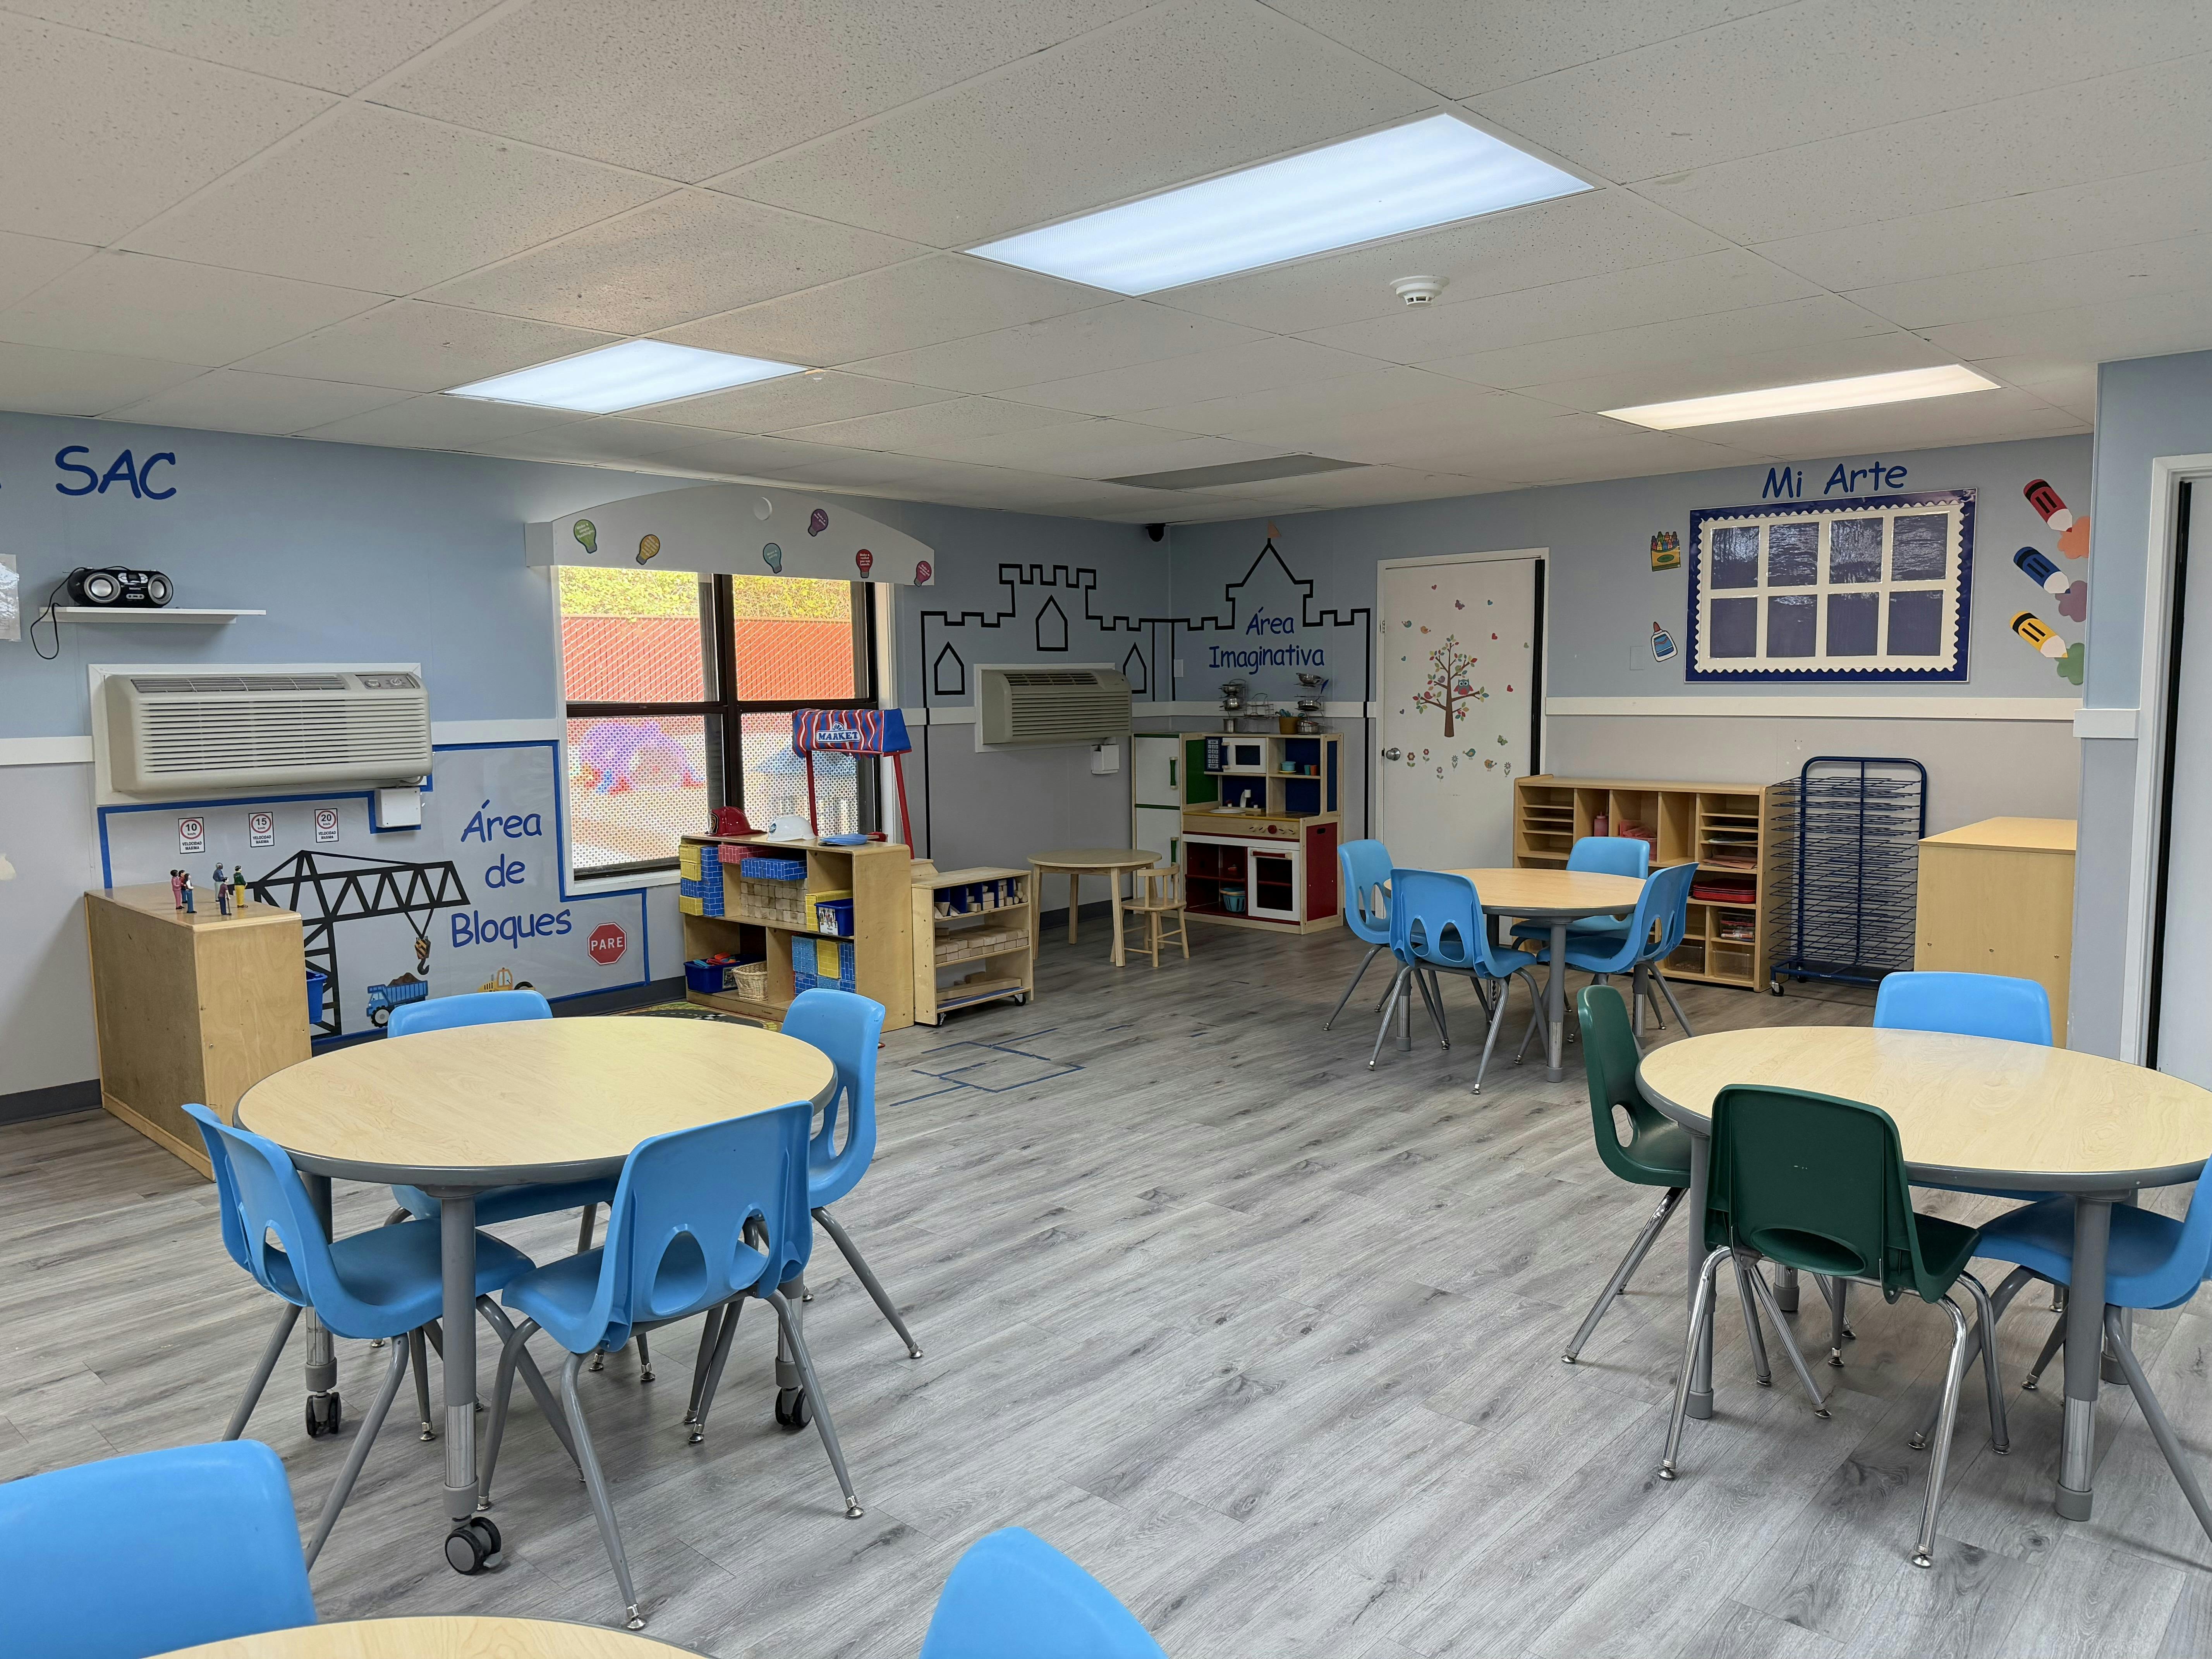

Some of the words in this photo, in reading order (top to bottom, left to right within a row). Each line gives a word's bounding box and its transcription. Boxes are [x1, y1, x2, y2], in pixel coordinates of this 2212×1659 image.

[55, 445, 177, 500] SAC
[1762, 466, 1803, 499] Mi
[1823, 461, 1908, 495] Arte
[1246, 607, 1294, 636] Área
[1209, 644, 1325, 675] Imaginativa
[818, 732, 858, 740] MARKET
[185, 823, 197, 831] 10
[256, 817, 267, 826] 15
[460, 799, 542, 842] Área
[485, 854, 526, 888] de
[452, 909, 572, 949] Bloques
[591, 936, 624, 951] PARE
